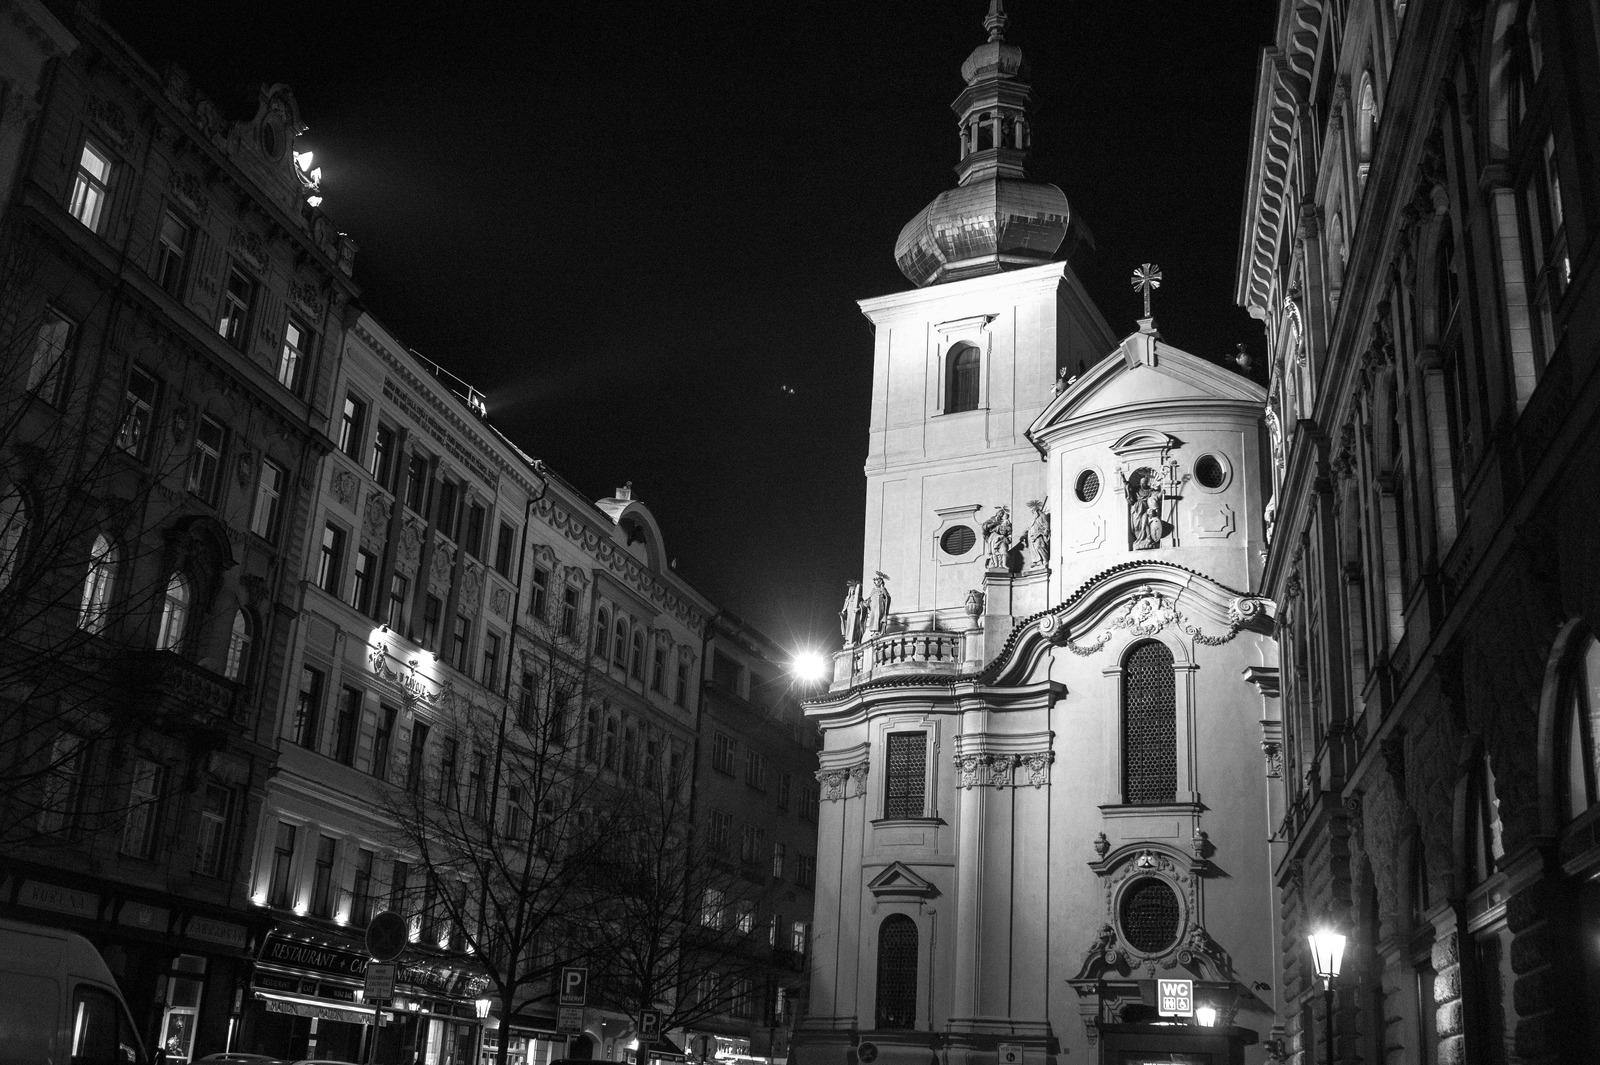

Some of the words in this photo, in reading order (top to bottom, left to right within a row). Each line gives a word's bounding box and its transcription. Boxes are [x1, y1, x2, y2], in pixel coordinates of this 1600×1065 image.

[271, 943, 337, 968] RESTAURANT
[566, 972, 581, 994] P
[1162, 983, 1189, 997] WC
[643, 1013, 657, 1033] P
